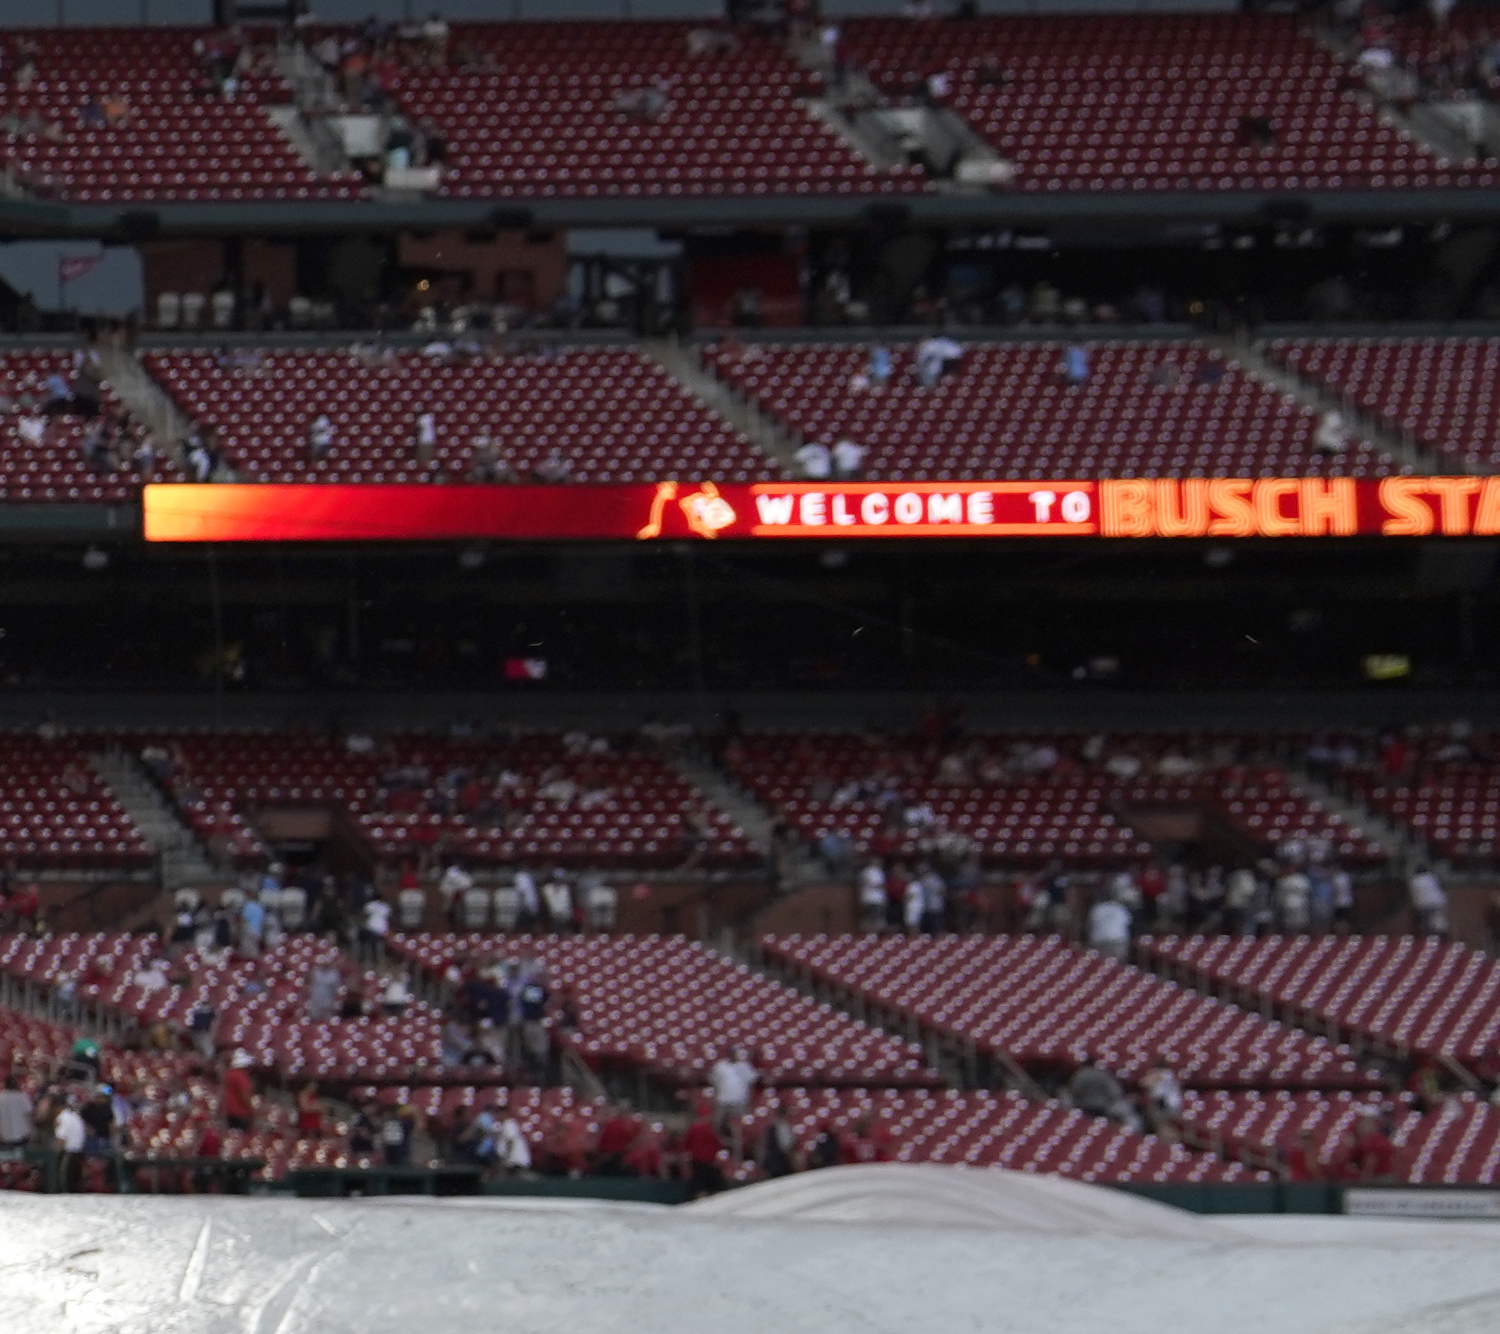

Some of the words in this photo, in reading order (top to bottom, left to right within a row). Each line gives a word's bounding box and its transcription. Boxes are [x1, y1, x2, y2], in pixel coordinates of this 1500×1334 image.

[755, 491, 995, 526] WELCOME
[1028, 490, 1091, 524] TO
[1102, 477, 1358, 537] BUSCH
